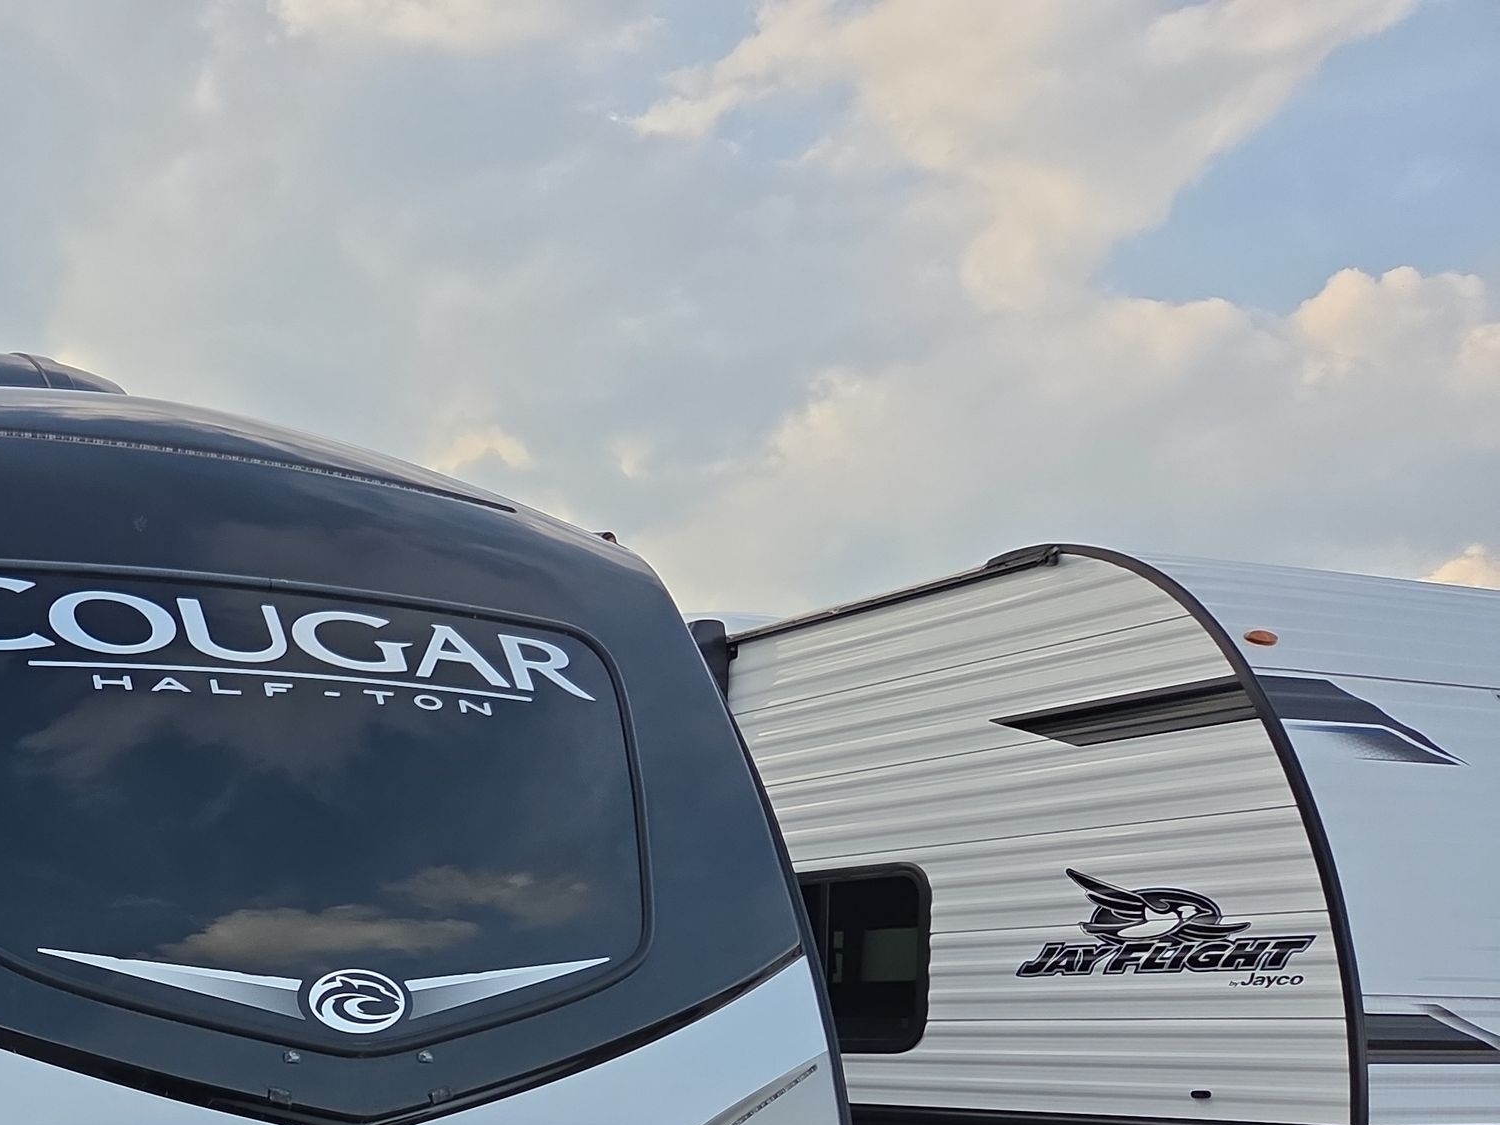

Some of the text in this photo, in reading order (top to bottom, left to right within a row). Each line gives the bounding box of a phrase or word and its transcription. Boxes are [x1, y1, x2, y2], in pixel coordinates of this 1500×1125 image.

[92, 674, 493, 717] HALF-TON
[1016, 934, 1317, 977] JAY FLIGHT
[1240, 972, 1304, 988] Jayco
